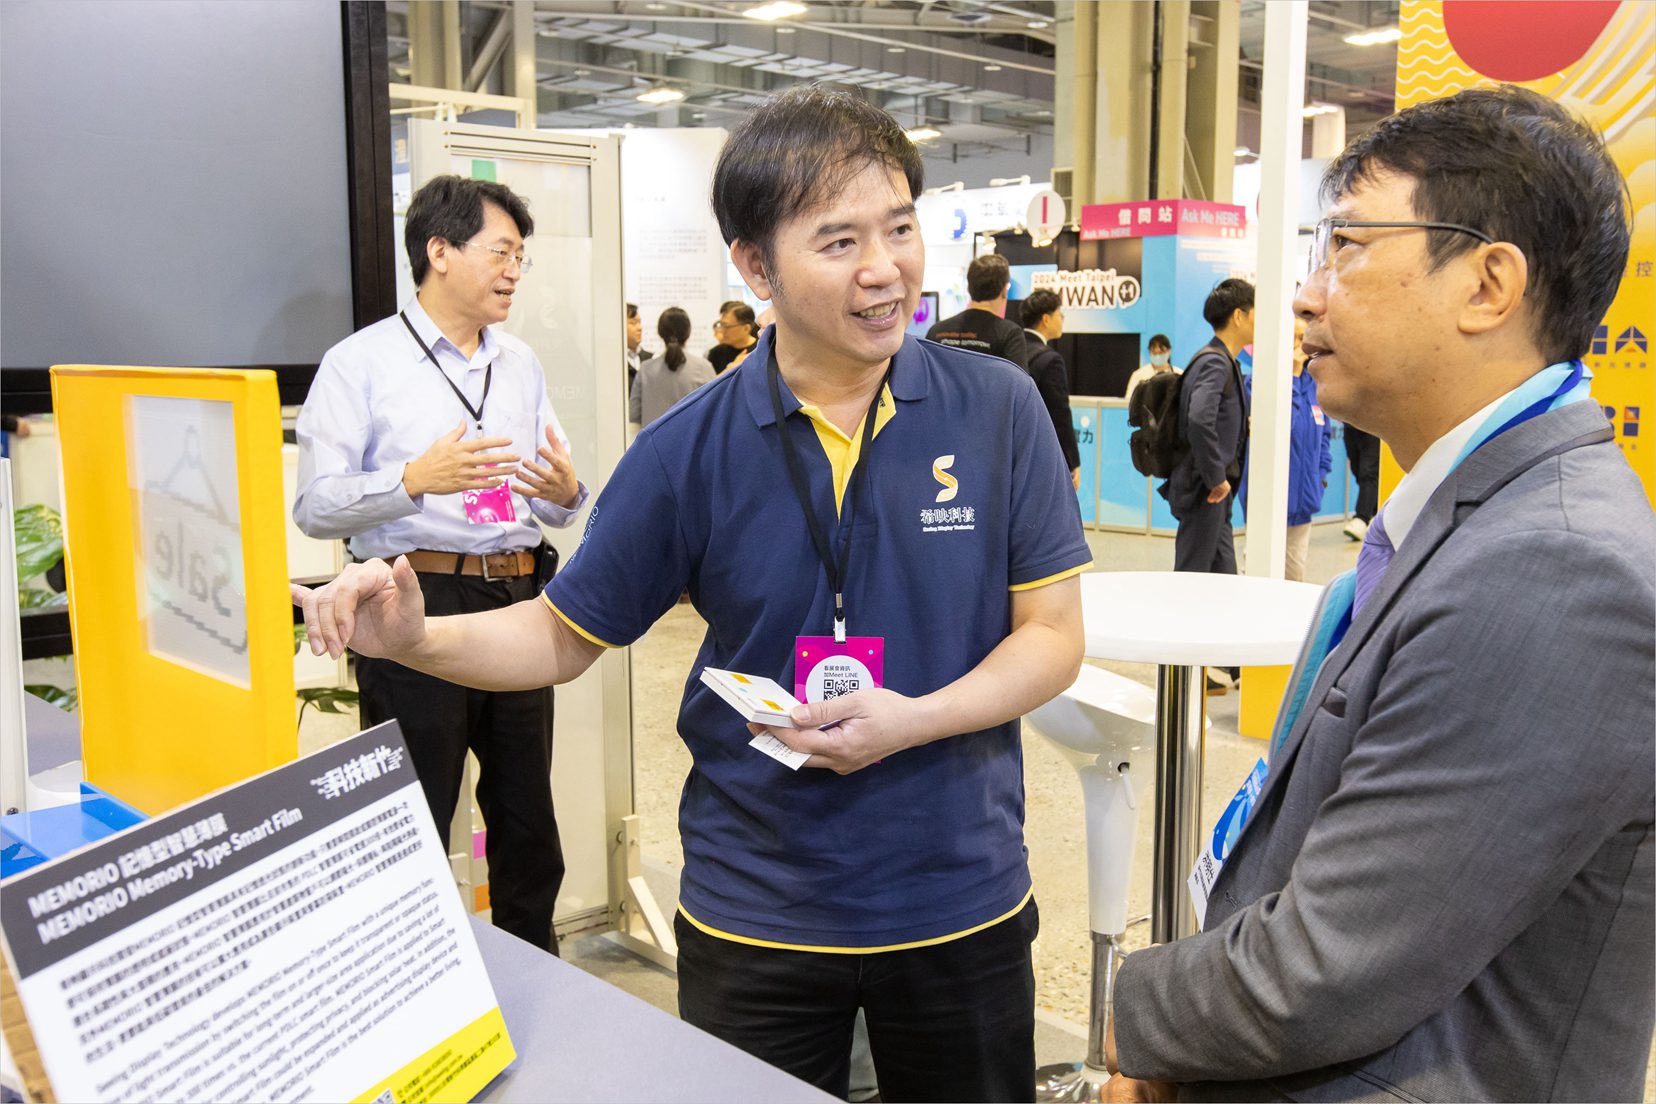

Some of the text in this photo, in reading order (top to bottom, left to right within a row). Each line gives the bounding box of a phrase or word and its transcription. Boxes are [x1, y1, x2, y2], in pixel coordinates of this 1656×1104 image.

[1182, 208, 1239, 226] Ask Me HERE
[1034, 274, 1056, 284] 2024
[1060, 274, 1081, 283] Meet
[28, 862, 119, 917] MEMORIO
[38, 887, 128, 943] MEMORIO
[128, 838, 232, 904] Memory-Type
[229, 817, 273, 850] Smart
[271, 803, 302, 830] Film
